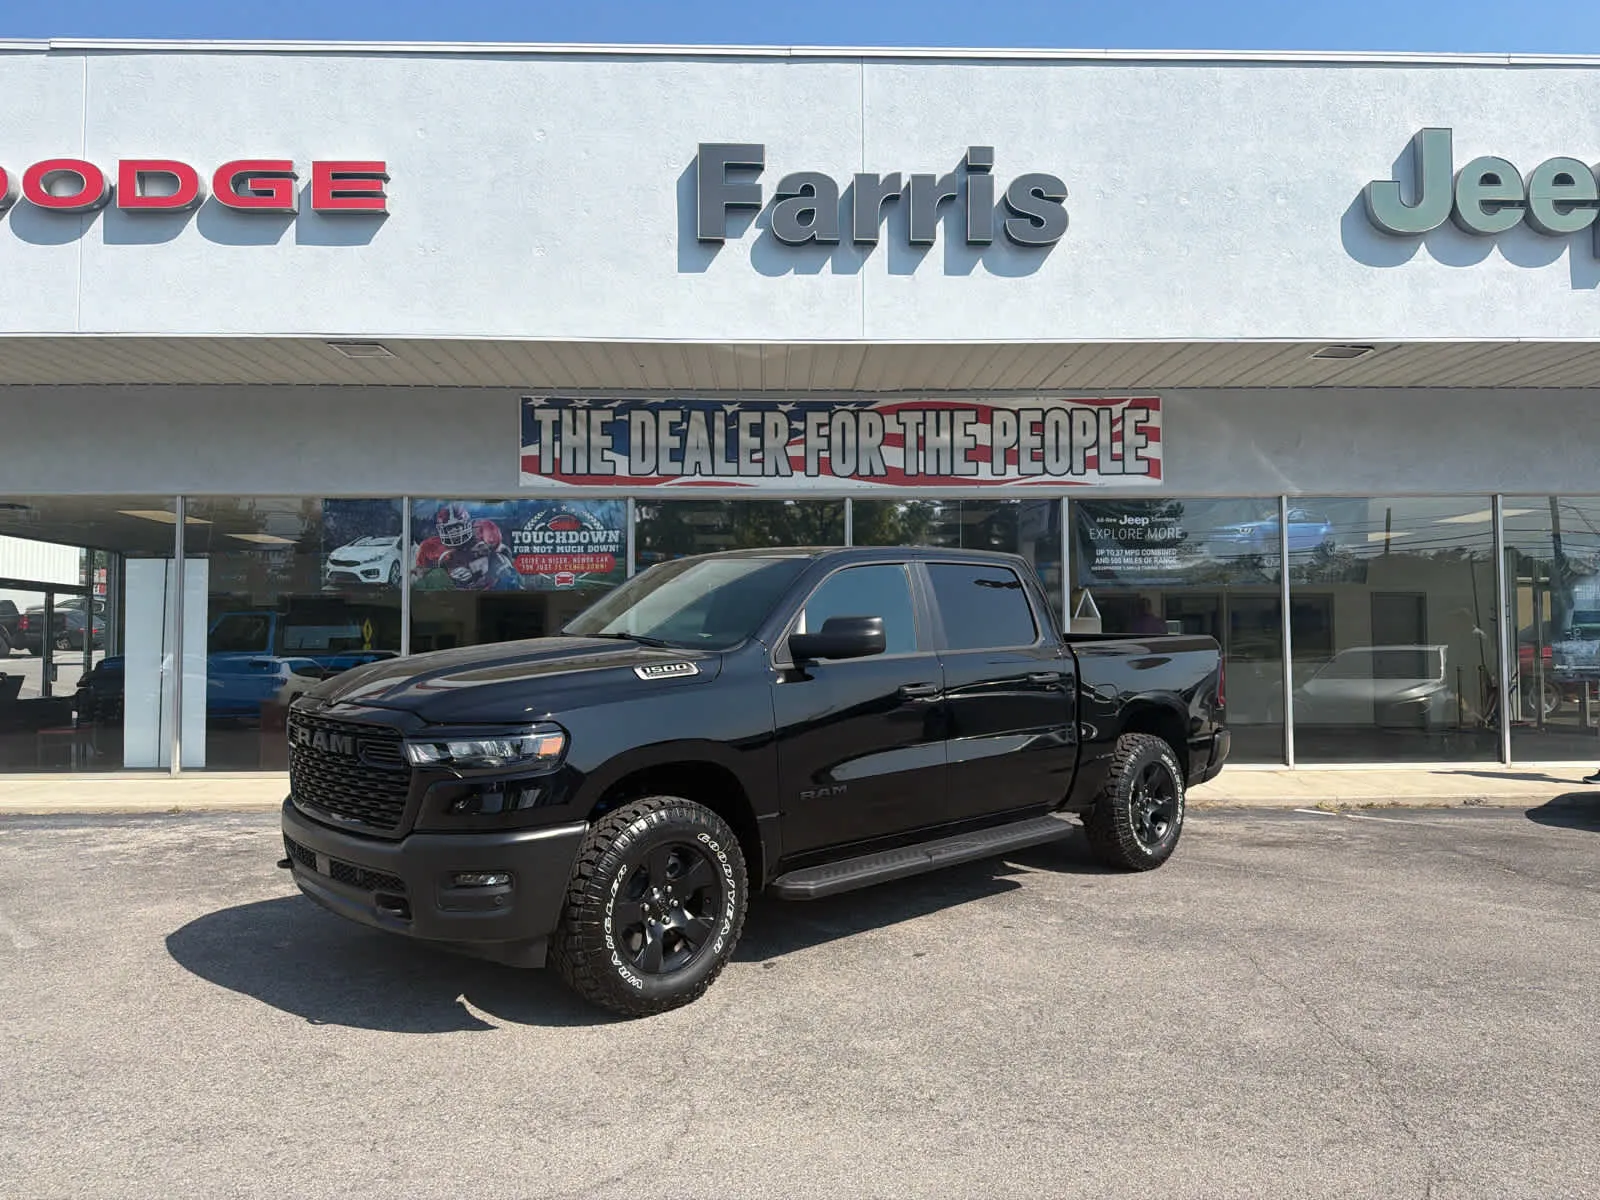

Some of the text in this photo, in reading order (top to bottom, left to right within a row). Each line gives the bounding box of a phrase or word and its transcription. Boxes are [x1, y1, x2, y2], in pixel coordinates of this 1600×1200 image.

[0, 159, 390, 214] ODGE
[697, 143, 1069, 246] Farris
[1364, 128, 1600, 256] Jee
[533, 405, 1151, 478] THE DEALER FOR THE PEOPLE
[1119, 515, 1149, 526] Jeep
[511, 530, 621, 544] TOUCHDOWN
[1089, 527, 1144, 540] EXPLORE
[513, 544, 620, 553] FOR NOT MUCH DOWN!
[1141, 548, 1177, 556] COMBINED
[1095, 557, 1110, 565] AND
[643, 663, 688, 674] 1500
[297, 727, 354, 755] RAM
[799, 784, 848, 800] RAM
[697, 832, 737, 954] GOODYEAR
[604, 864, 643, 990] WRANGLER
